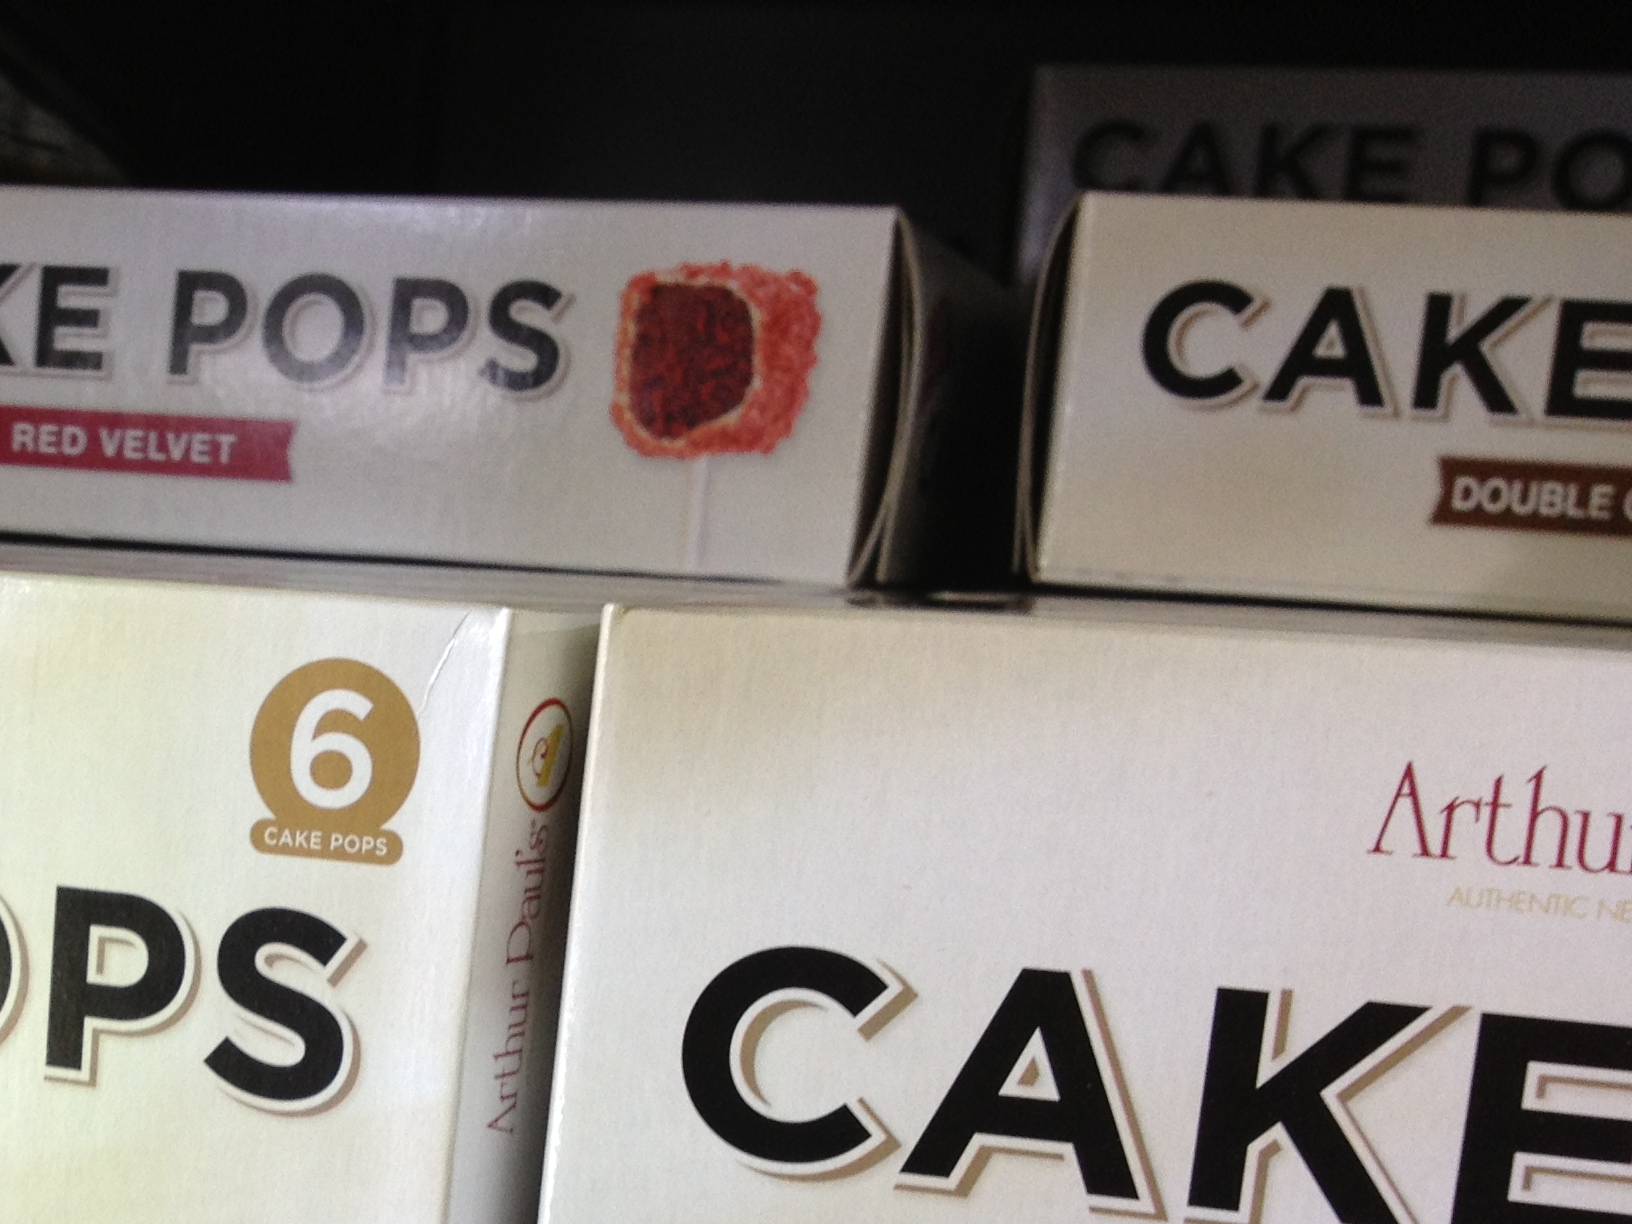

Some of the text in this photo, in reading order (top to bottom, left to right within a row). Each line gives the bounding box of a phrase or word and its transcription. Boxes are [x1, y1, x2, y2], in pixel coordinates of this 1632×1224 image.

[168, 267, 572, 397] POPS
[1142, 279, 1632, 428] CAKE
[11, 422, 238, 466] RED VELVET
[1451, 474, 1616, 521] DOUBLE
[290, 688, 374, 811] 6
[264, 826, 388, 858] CAKE POPS
[1367, 760, 1632, 877] Arthu
[1446, 887, 1592, 920] AUTHENTIC
[486, 984, 533, 1137] Arthur
